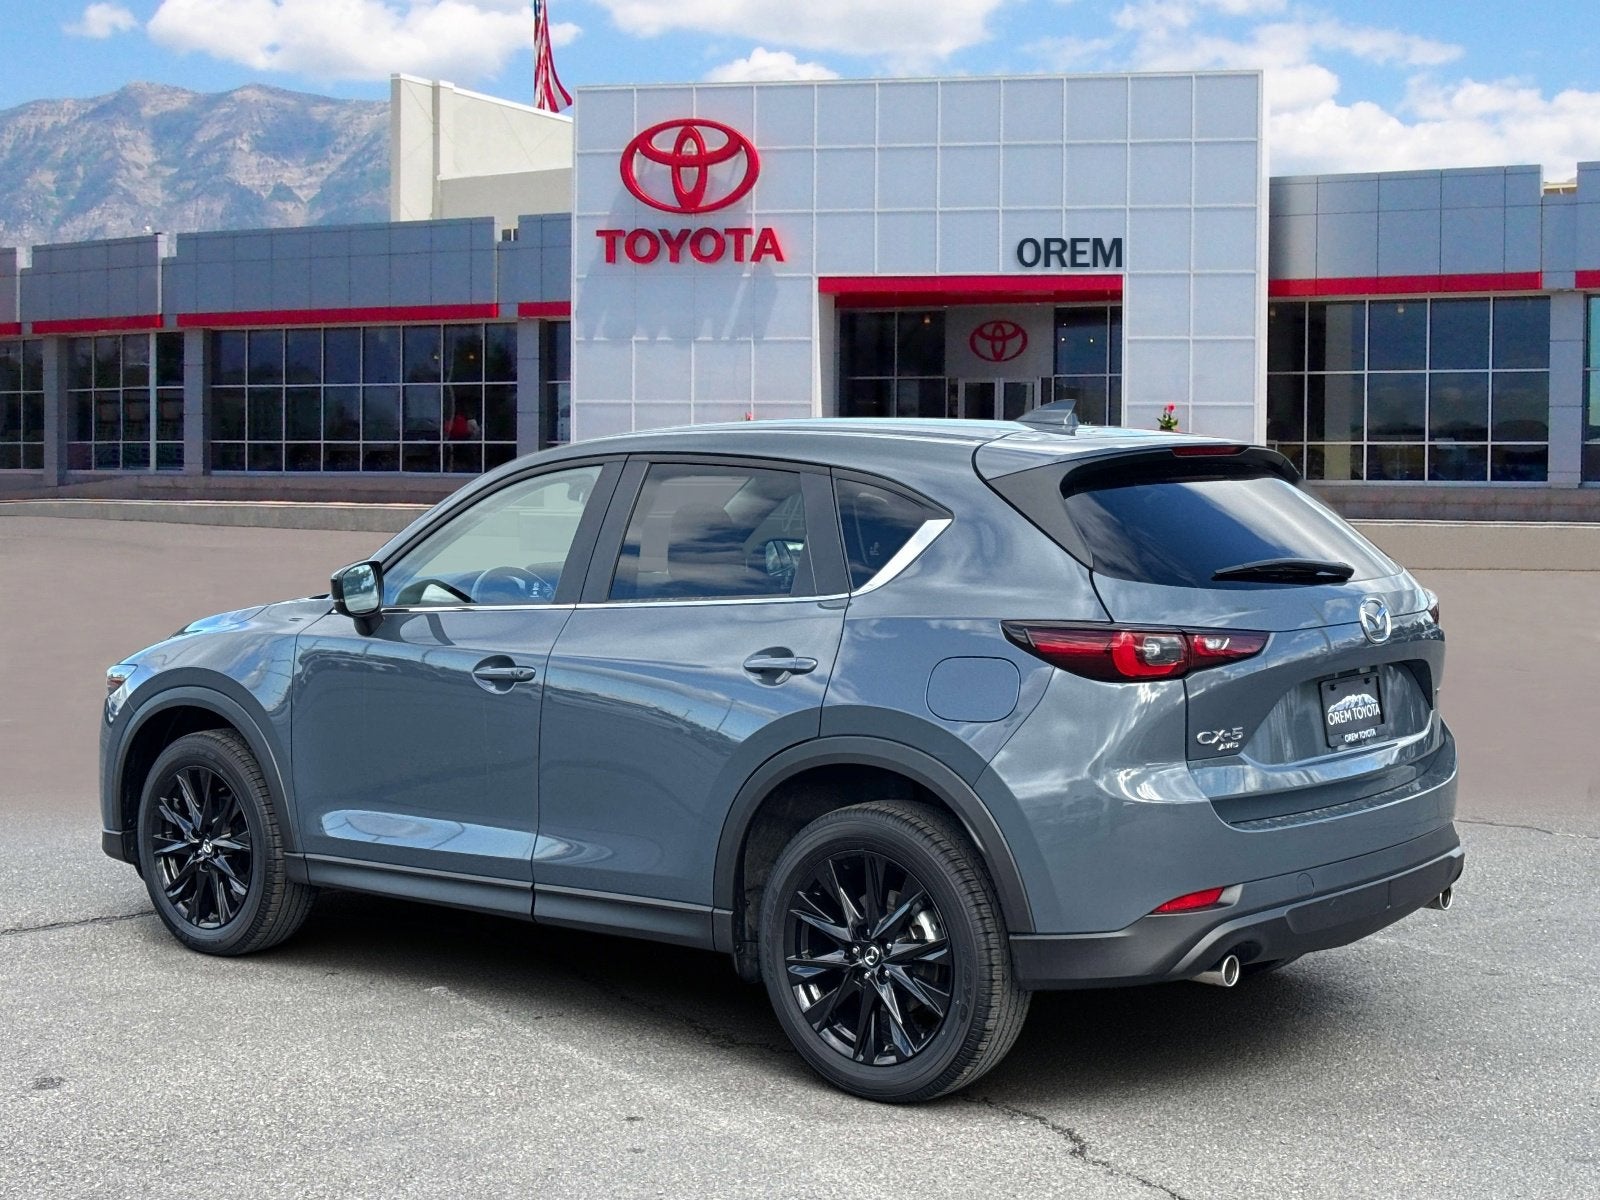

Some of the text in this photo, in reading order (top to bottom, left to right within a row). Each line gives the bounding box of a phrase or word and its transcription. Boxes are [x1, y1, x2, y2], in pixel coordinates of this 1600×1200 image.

[597, 227, 784, 264] TOYOTA
[1017, 237, 1123, 268] OREM
[1327, 703, 1381, 726] OREM TOYOTA
[1196, 726, 1244, 745] CX-5
[1217, 741, 1239, 751] AWD
[1344, 728, 1376, 743] OREM TOYOTA
